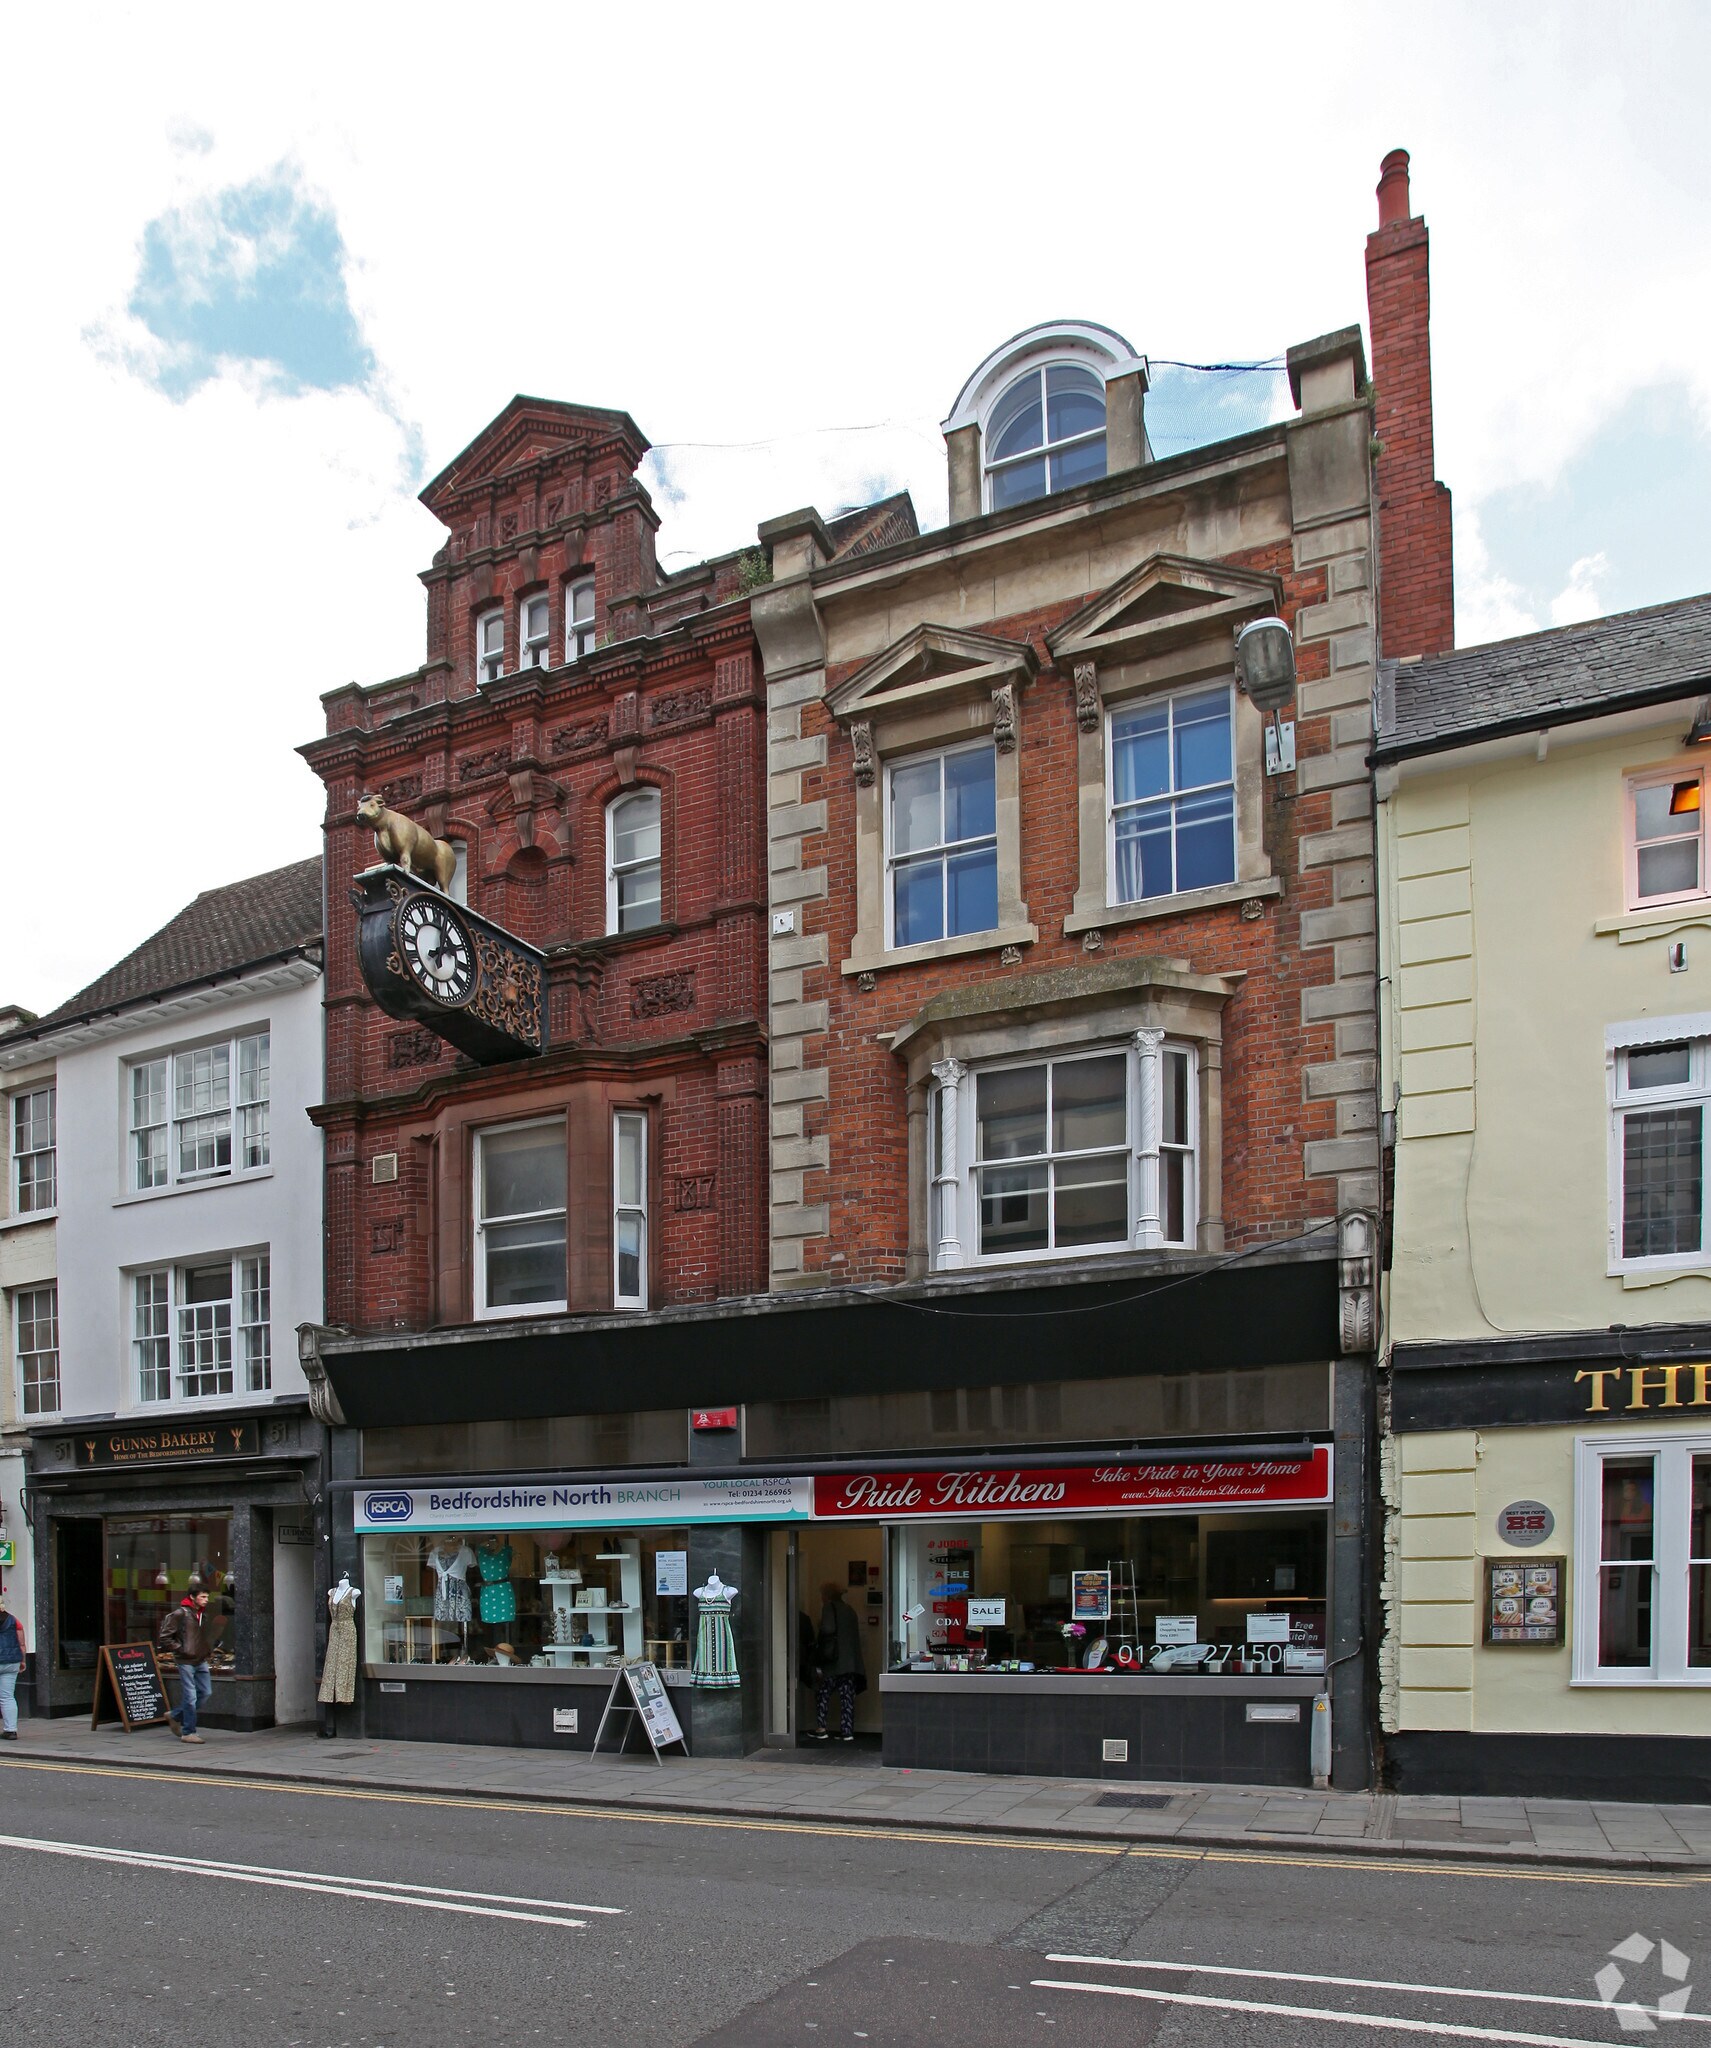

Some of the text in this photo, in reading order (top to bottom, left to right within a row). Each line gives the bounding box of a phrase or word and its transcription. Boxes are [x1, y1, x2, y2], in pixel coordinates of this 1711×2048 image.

[271, 1424, 287, 1442] 51
[109, 1431, 216, 1452] GUNNS BAKERY
[55, 1443, 71, 1460] 51
[113, 1453, 129, 1461] HOME
[137, 1451, 148, 1459] THE
[188, 1447, 214, 1455] CLANGER
[1092, 1462, 1302, 1484] Take Pride in Your Home
[703, 1477, 792, 1489] YOUR LOCAL RSPCA
[837, 1471, 1066, 1509] Pride Kitchens
[430, 1486, 681, 1510] Bedfordshire North BRANCH
[728, 1488, 792, 1498] Tel: 01234 266965
[1121, 1484, 1266, 1500] www.PrideKitchensLtd.co.uk
[371, 1500, 407, 1514] RSPCA
[937, 1540, 969, 1549] JUDGE
[971, 1607, 1001, 1615] SALE
[935, 1617, 960, 1626] CDA
[1294, 1621, 1314, 1630] Free
